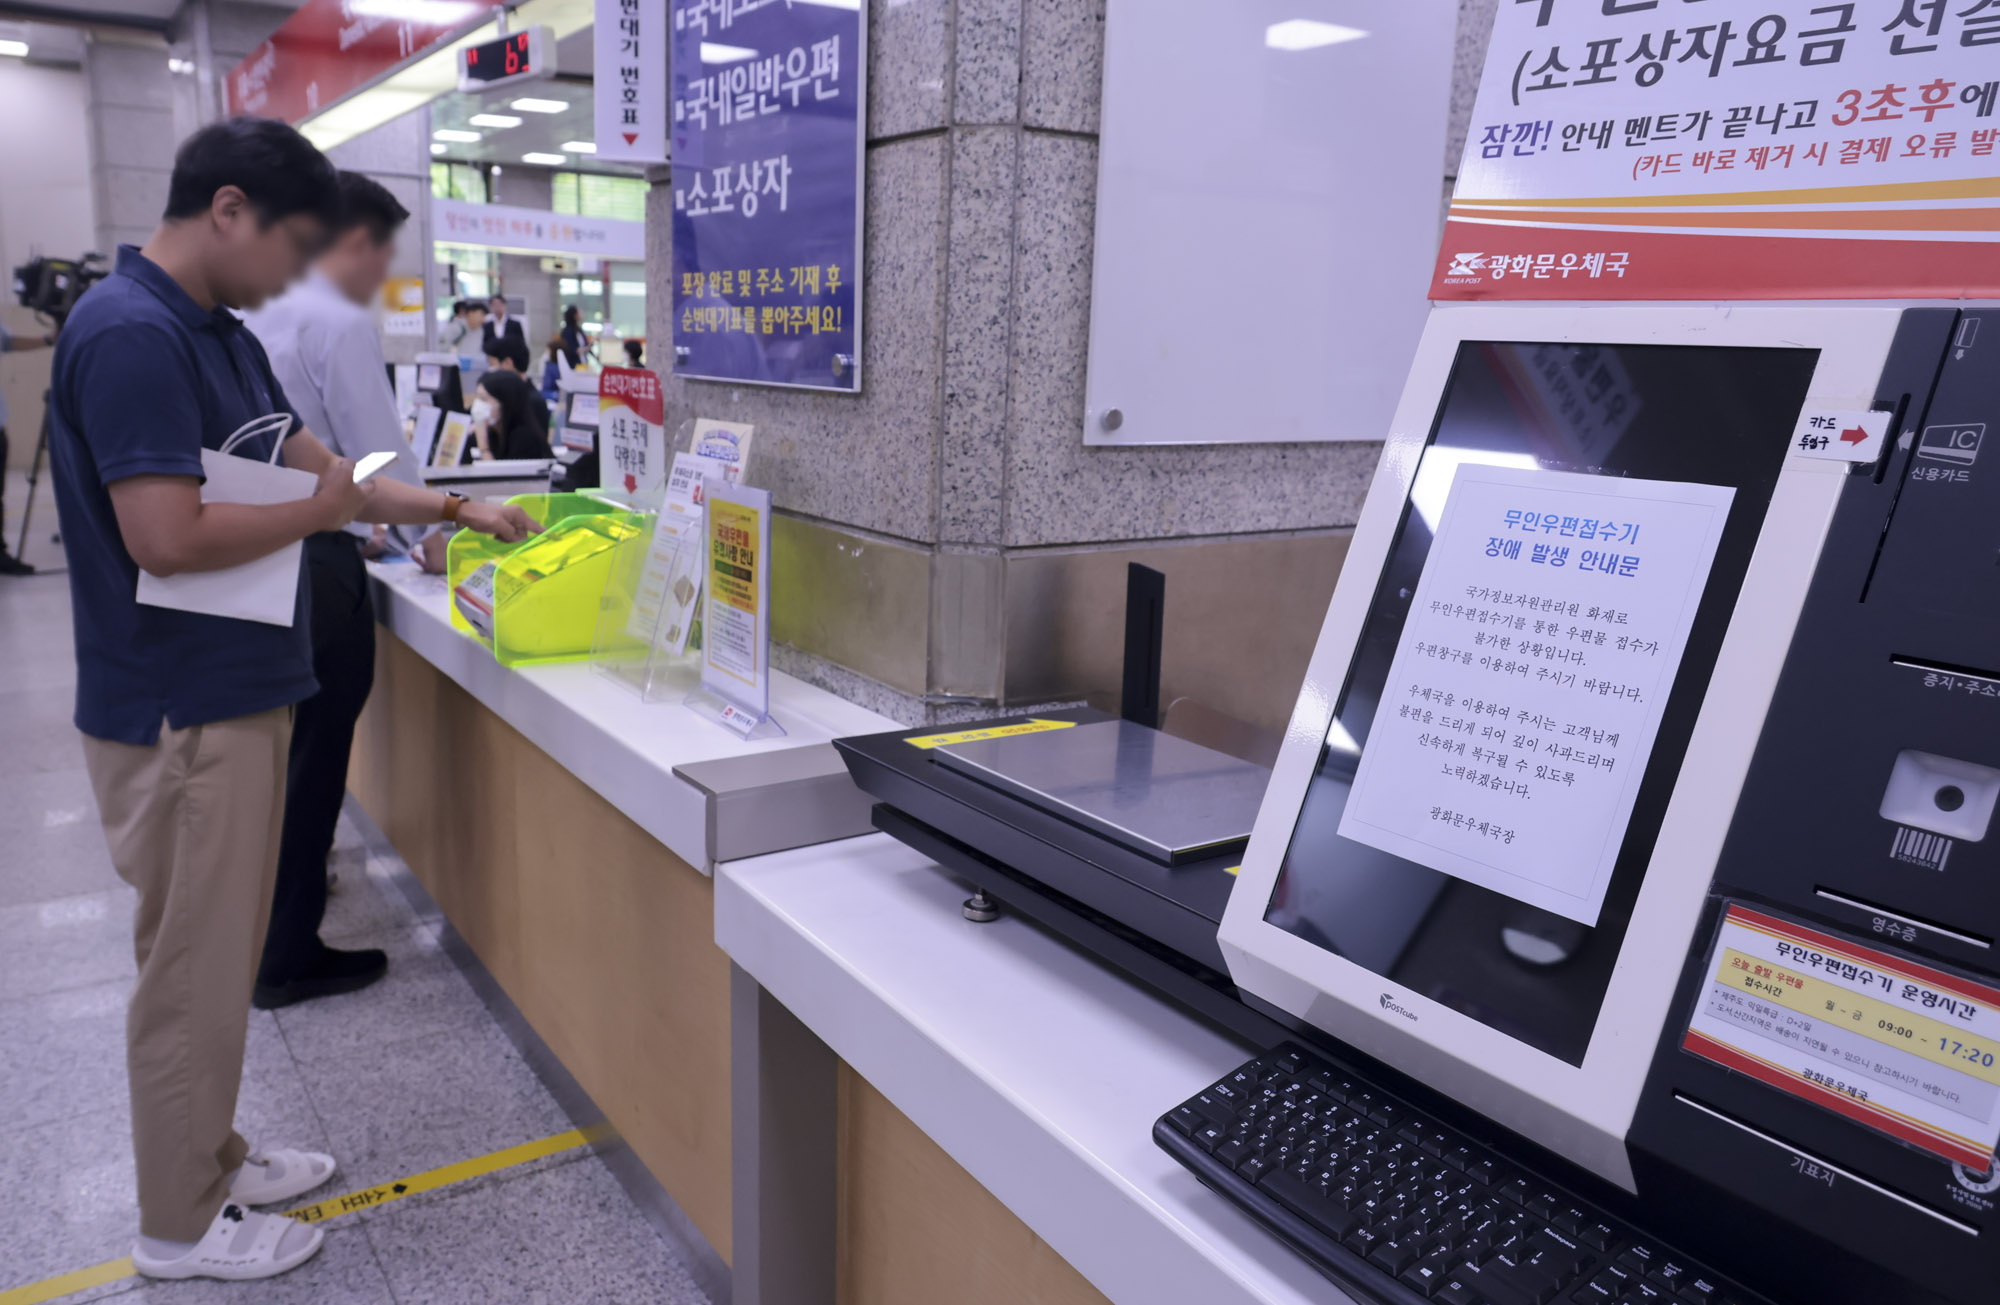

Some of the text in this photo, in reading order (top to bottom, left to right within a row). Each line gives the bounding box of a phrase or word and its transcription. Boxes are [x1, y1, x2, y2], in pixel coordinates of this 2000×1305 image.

[1511, 4, 1856, 106] (소포상자요금
[620, 66, 640, 125] 번호표
[686, 34, 840, 131] 국내일반우편
[1480, 120, 1554, 159] 잠깐!
[1561, 120, 1615, 152] 안내
[1624, 110, 1713, 147] 멘트가
[1723, 100, 1819, 139] 끝나고
[1632, 153, 1683, 181] (카드
[1692, 149, 1737, 174] 바로
[1744, 144, 1794, 171] 제거
[1802, 142, 1829, 167] 시
[1838, 136, 1892, 166] 결제
[1900, 132, 1957, 159] 오류
[686, 153, 793, 218] 소포상자
[681, 264, 842, 299] 포장 완료 및 주소 기재 후
[1488, 253, 1630, 280] 광화문우체국
[682, 305, 842, 335] 순번대기표를 뽑아주세요!
[1810, 416, 1836, 429] 카드
[1949, 430, 1977, 449] IC
[1912, 467, 1970, 482] 신용카드
[1503, 509, 1640, 545] 무인우편접수기
[1485, 537, 1640, 577] 장애 발생 안내문
[1466, 585, 1628, 625] 국가정보자원관리원 화재로
[1430, 601, 1660, 656] 무인우편접수기를 통한 우편물 접수가
[1474, 632, 1586, 666] 불가한 상황입니다.
[1415, 642, 1643, 703] 우편창구를 이용하여 주시기 바랍니다.
[1923, 672, 2000, 697] 증지•주소
[1409, 684, 1620, 748] 우체국을 이용하여 주시는 고객님께
[1399, 704, 1615, 773] 불편을 드리게 되어 깊이 사과드리며
[1418, 733, 1576, 787] 신속하게 복구될 수 있도록
[1441, 763, 1531, 800] 노력하겠습니다.
[1430, 806, 1515, 845] 광화문우체국장
[1872, 917, 1917, 942] 영수증
[1731, 957, 1804, 989] 오늘 출발 우편물
[1776, 941, 1977, 1021] 무인우편접수기 운영시간
[1720, 991, 1744, 1006] 제주도
[1748, 1001, 1778, 1019] 익일특급
[1744, 976, 1783, 997] 접수시간
[1825, 999, 1835, 1012] 월
[1852, 1010, 1863, 1021] 금
[1878, 1019, 1913, 1039] 09:00
[1939, 1037, 1994, 1068] 17:20
[1775, 1026, 1799, 1041] 배송이
[1803, 1036, 1828, 1052] 지연될
[1831, 1047, 1840, 1056] 수
[1845, 1051, 1870, 1069] 있으니
[1873, 1063, 1918, 1087] 참고하시기
[1922, 1082, 1961, 1103] 바랍니다.
[1802, 1067, 1868, 1102] 광화문우체국
[1791, 1156, 1835, 1187] 기표지
[1570, 1209, 1582, 1217] F11
[1598, 1224, 1611, 1233] F12
[1544, 1227, 1576, 1249] Backspace
[1466, 1261, 1480, 1273] Shift
[1498, 1254, 1516, 1267] Enter
[1609, 1266, 1627, 1279] Insert
[1589, 1281, 1608, 1295] Delete
[1639, 1283, 1658, 1296] Home
